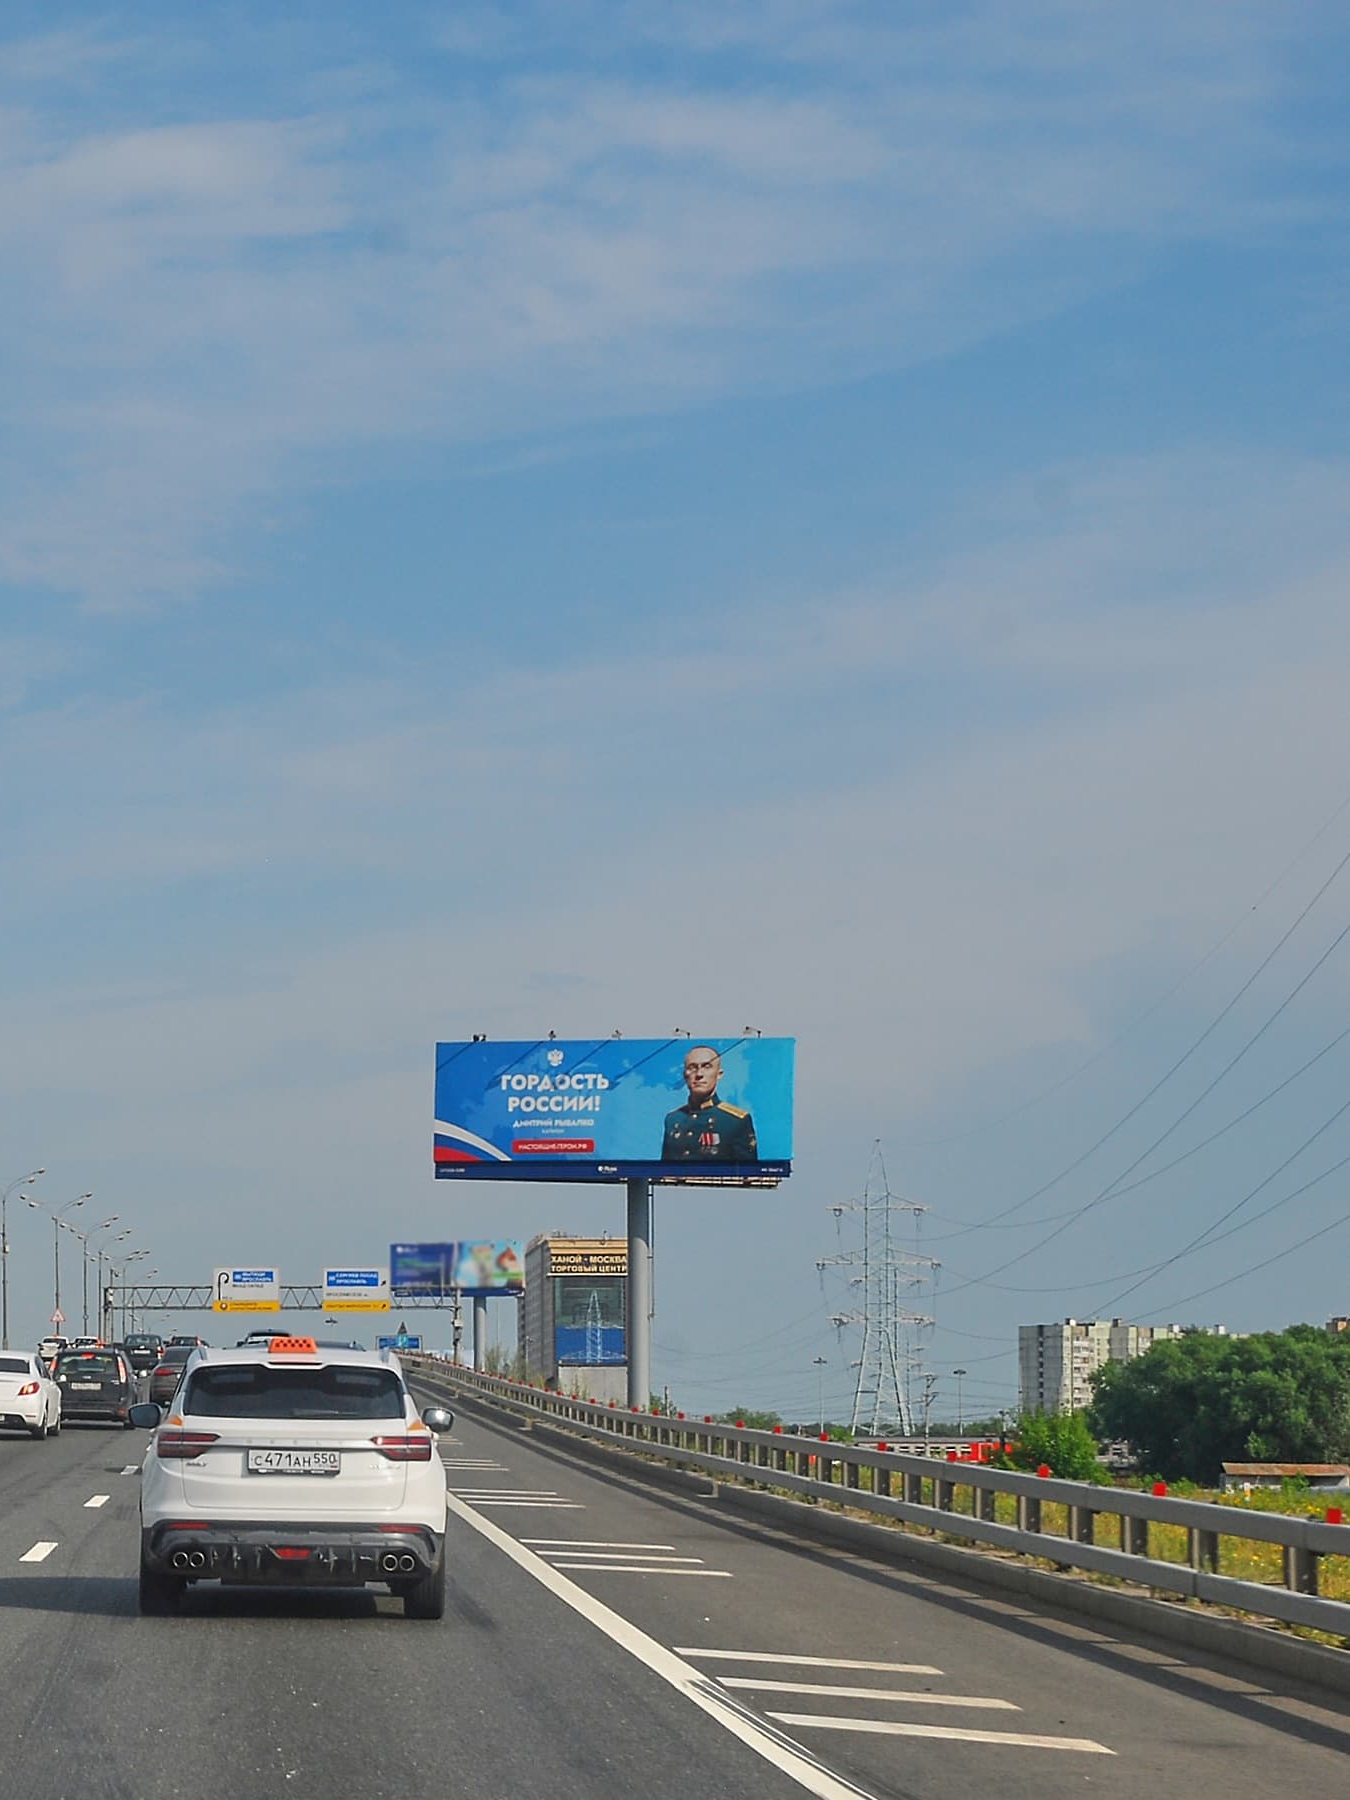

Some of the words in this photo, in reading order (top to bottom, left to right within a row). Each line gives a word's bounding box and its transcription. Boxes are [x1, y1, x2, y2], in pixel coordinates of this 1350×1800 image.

[500, 1073, 610, 1092] ГОРДОСТЬ
[507, 1095, 601, 1112] РОССИИ!
[551, 1255, 582, 1264] ХАНОЙ
[589, 1255, 627, 1264] МОСКВА
[551, 1265, 597, 1273] ТОРГОВЫЙ
